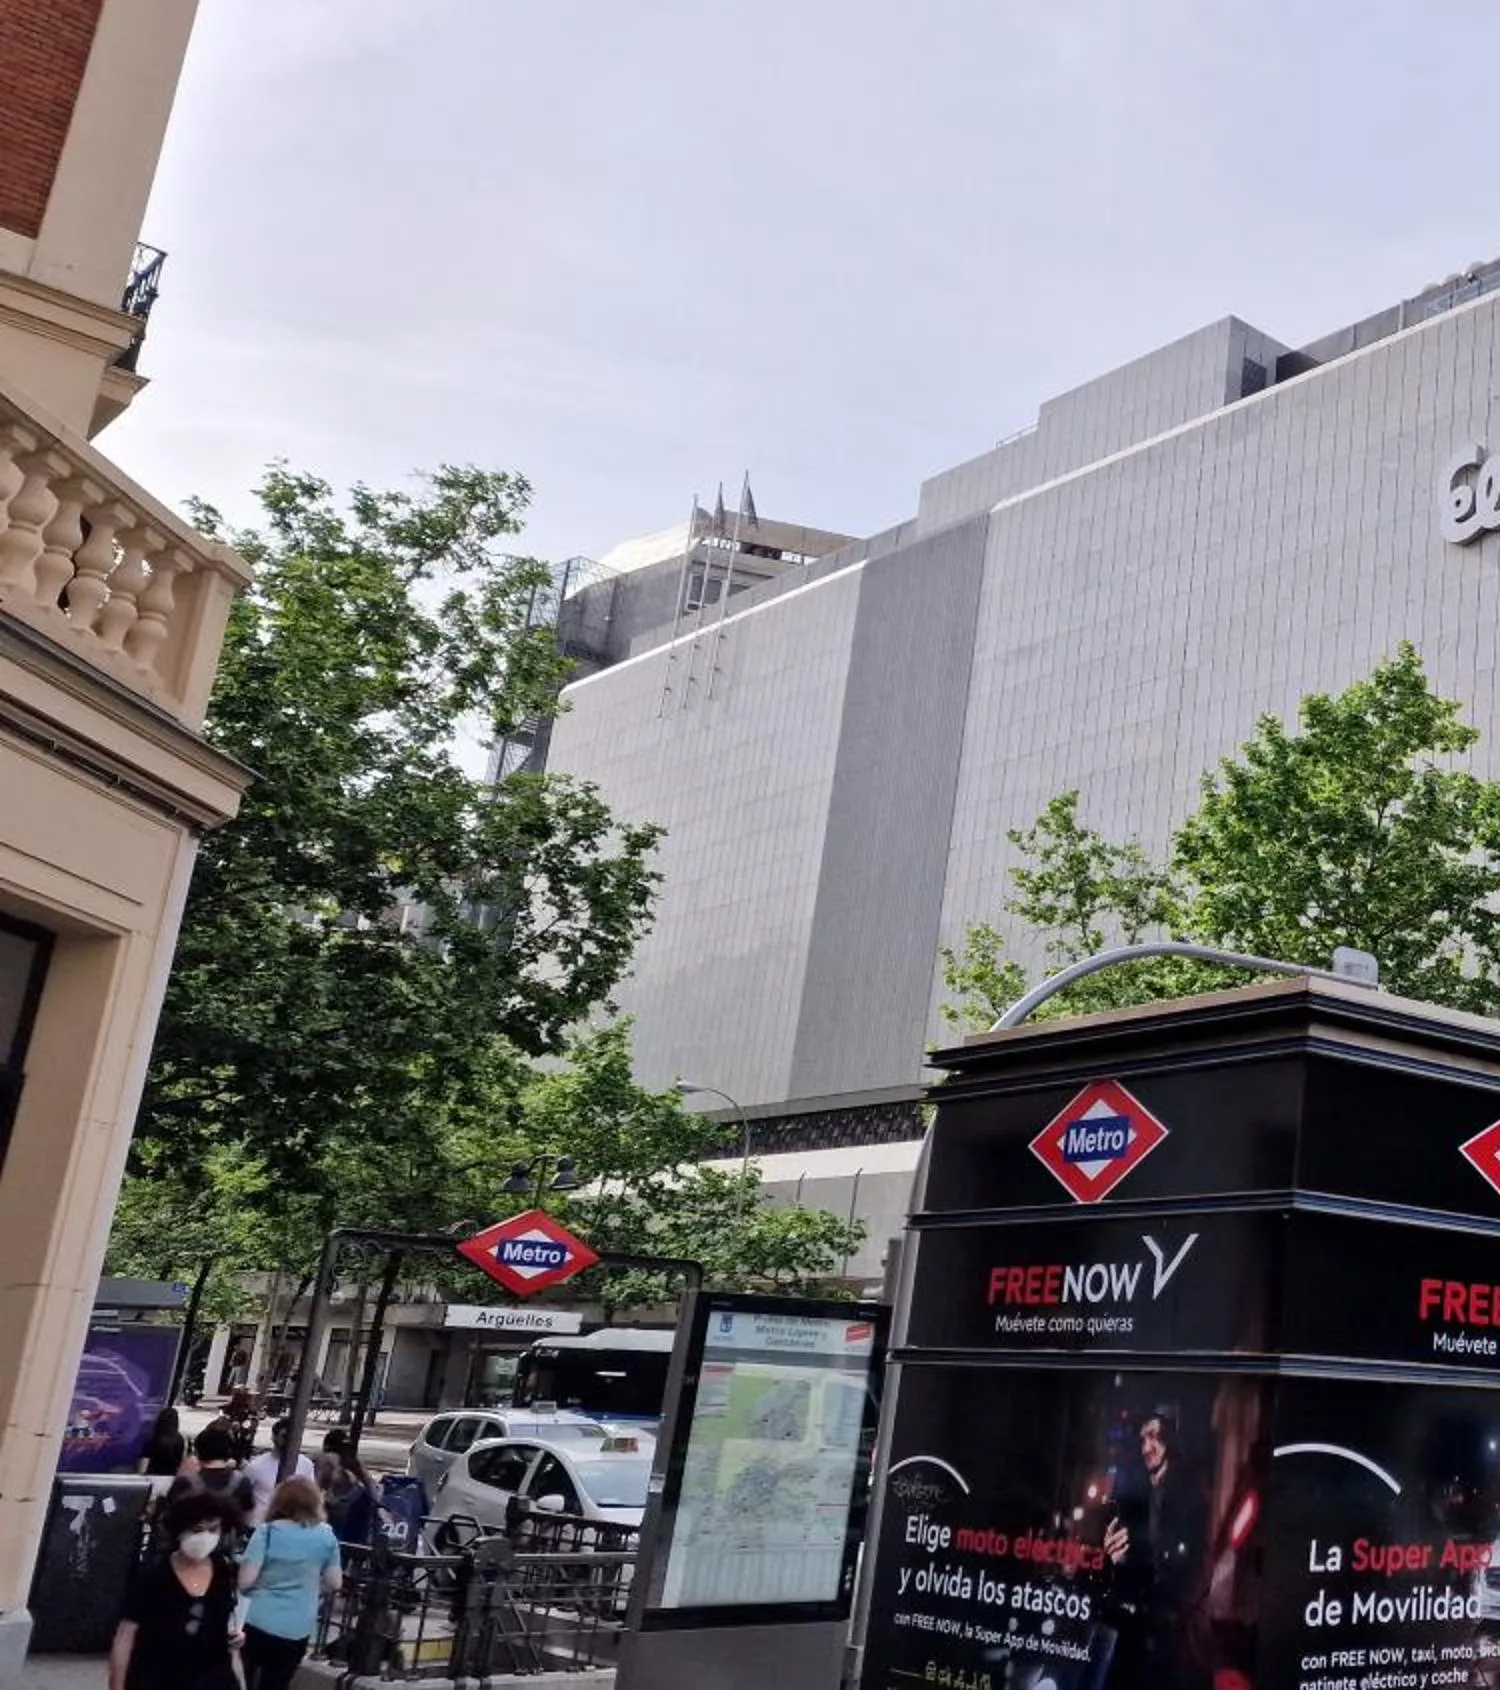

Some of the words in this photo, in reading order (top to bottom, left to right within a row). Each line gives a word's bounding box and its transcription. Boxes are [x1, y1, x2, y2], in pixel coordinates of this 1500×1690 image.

[1066, 1122, 1125, 1154] Metro
[503, 1242, 561, 1263] Metro
[987, 1262, 1143, 1306] FREENOW
[476, 1311, 554, 1328] Argüelles
[995, 1311, 1046, 1333] Muévete
[1048, 1316, 1084, 1332] como
[1087, 1314, 1133, 1333] quieras
[1433, 1330, 1498, 1356] Muévete
[904, 1513, 951, 1552] Elige
[956, 1526, 1008, 1555] moto
[1014, 1527, 1105, 1570] eléctrica
[1308, 1539, 1342, 1573] La
[1351, 1537, 1433, 1578] Super
[1440, 1537, 1495, 1577] App
[897, 1567, 912, 1595] y
[915, 1561, 972, 1600] olvida
[977, 1569, 1006, 1606] los
[1011, 1581, 1091, 1620] atascos
[1304, 1590, 1342, 1628] de
[1351, 1585, 1483, 1625] Movilidad
[893, 1612, 911, 1626] con
[911, 1613, 936, 1631] FREE
[964, 1624, 974, 1637] la
[974, 1625, 1003, 1644] Super
[1003, 1631, 1025, 1650] App
[1025, 1633, 1040, 1651] de
[1301, 1654, 1328, 1671] con
[1330, 1649, 1366, 1669] FREE
[1369, 1647, 1408, 1667] NOW,
[1411, 1643, 1438, 1664] taxi,
[1441, 1645, 1477, 1661] moto,
[1298, 1676, 1358, 1690] patinete
[1359, 1670, 1417, 1690] eléctrico
[1419, 1672, 1429, 1688] y
[1431, 1667, 1469, 1685] coche
